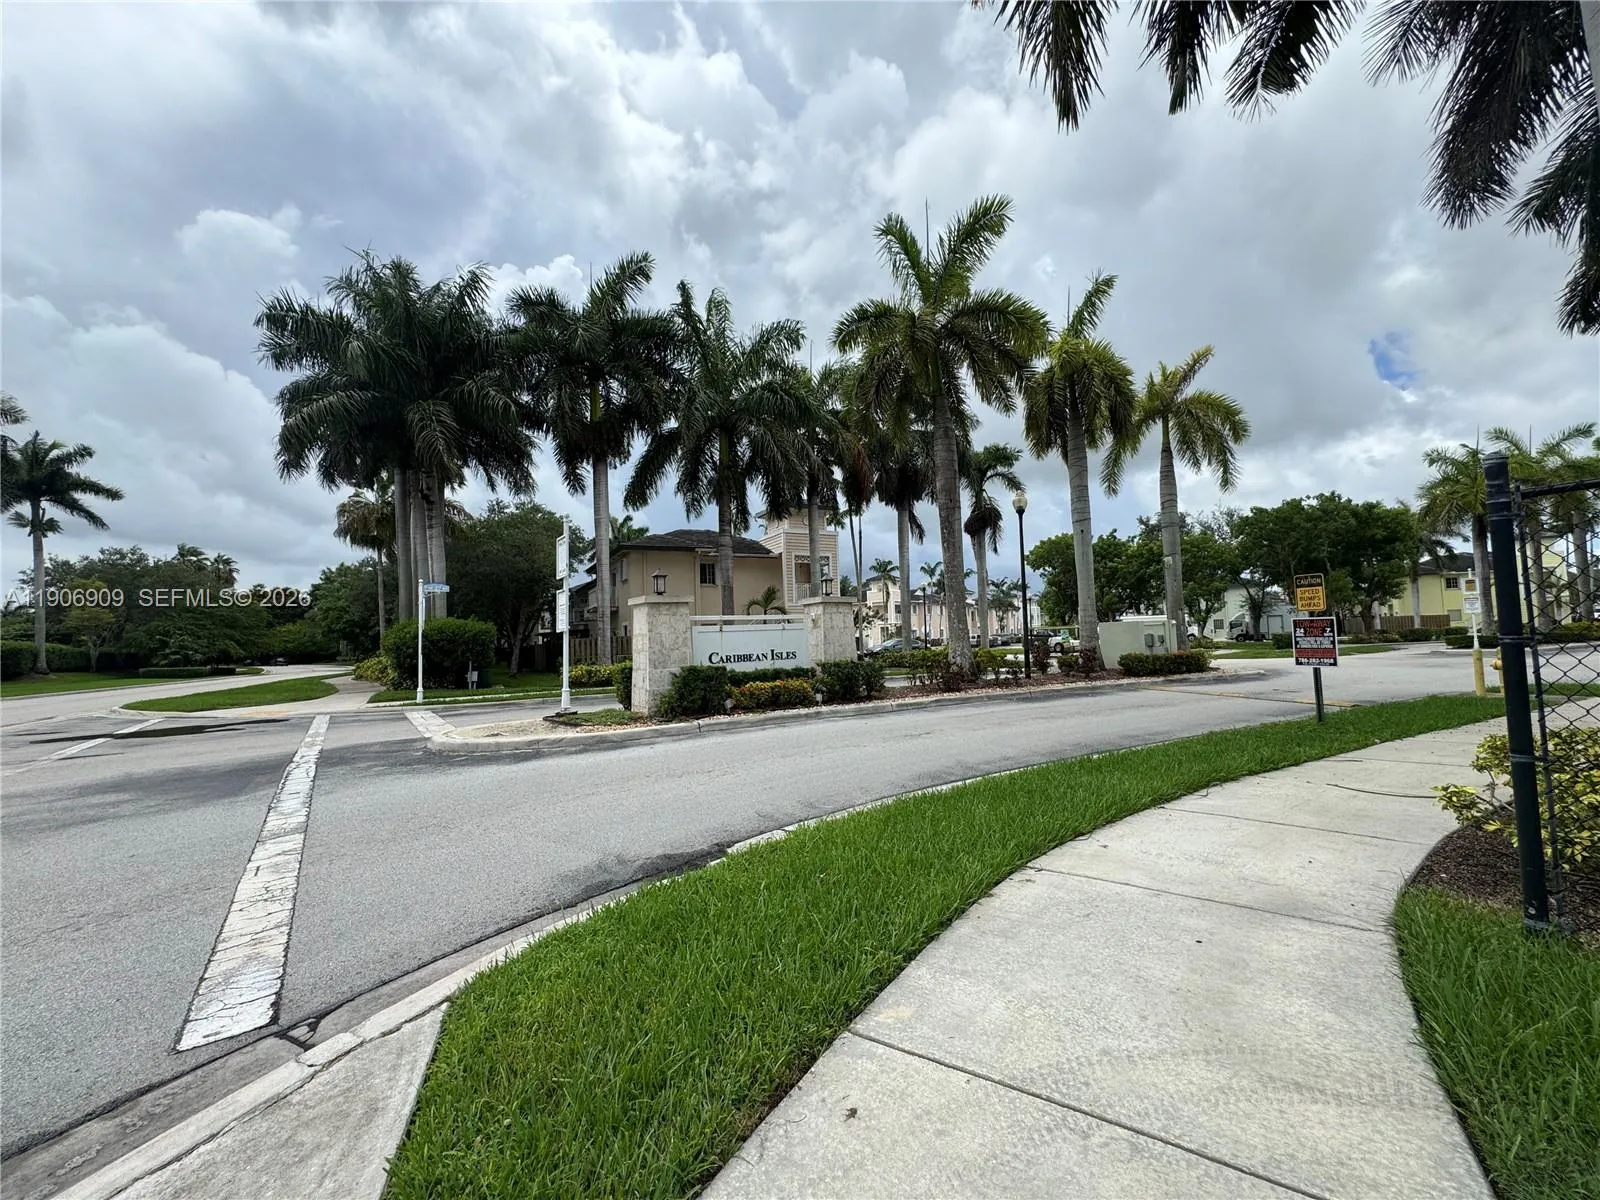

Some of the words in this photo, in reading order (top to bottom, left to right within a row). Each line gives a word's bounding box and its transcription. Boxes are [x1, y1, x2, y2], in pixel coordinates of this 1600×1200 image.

[1296, 620, 1331, 628] TOW-AWAY
[1306, 627, 1323, 636] ZONE
[708, 652, 768, 664] CARIBBEAN
[770, 649, 797, 661] ISLES
